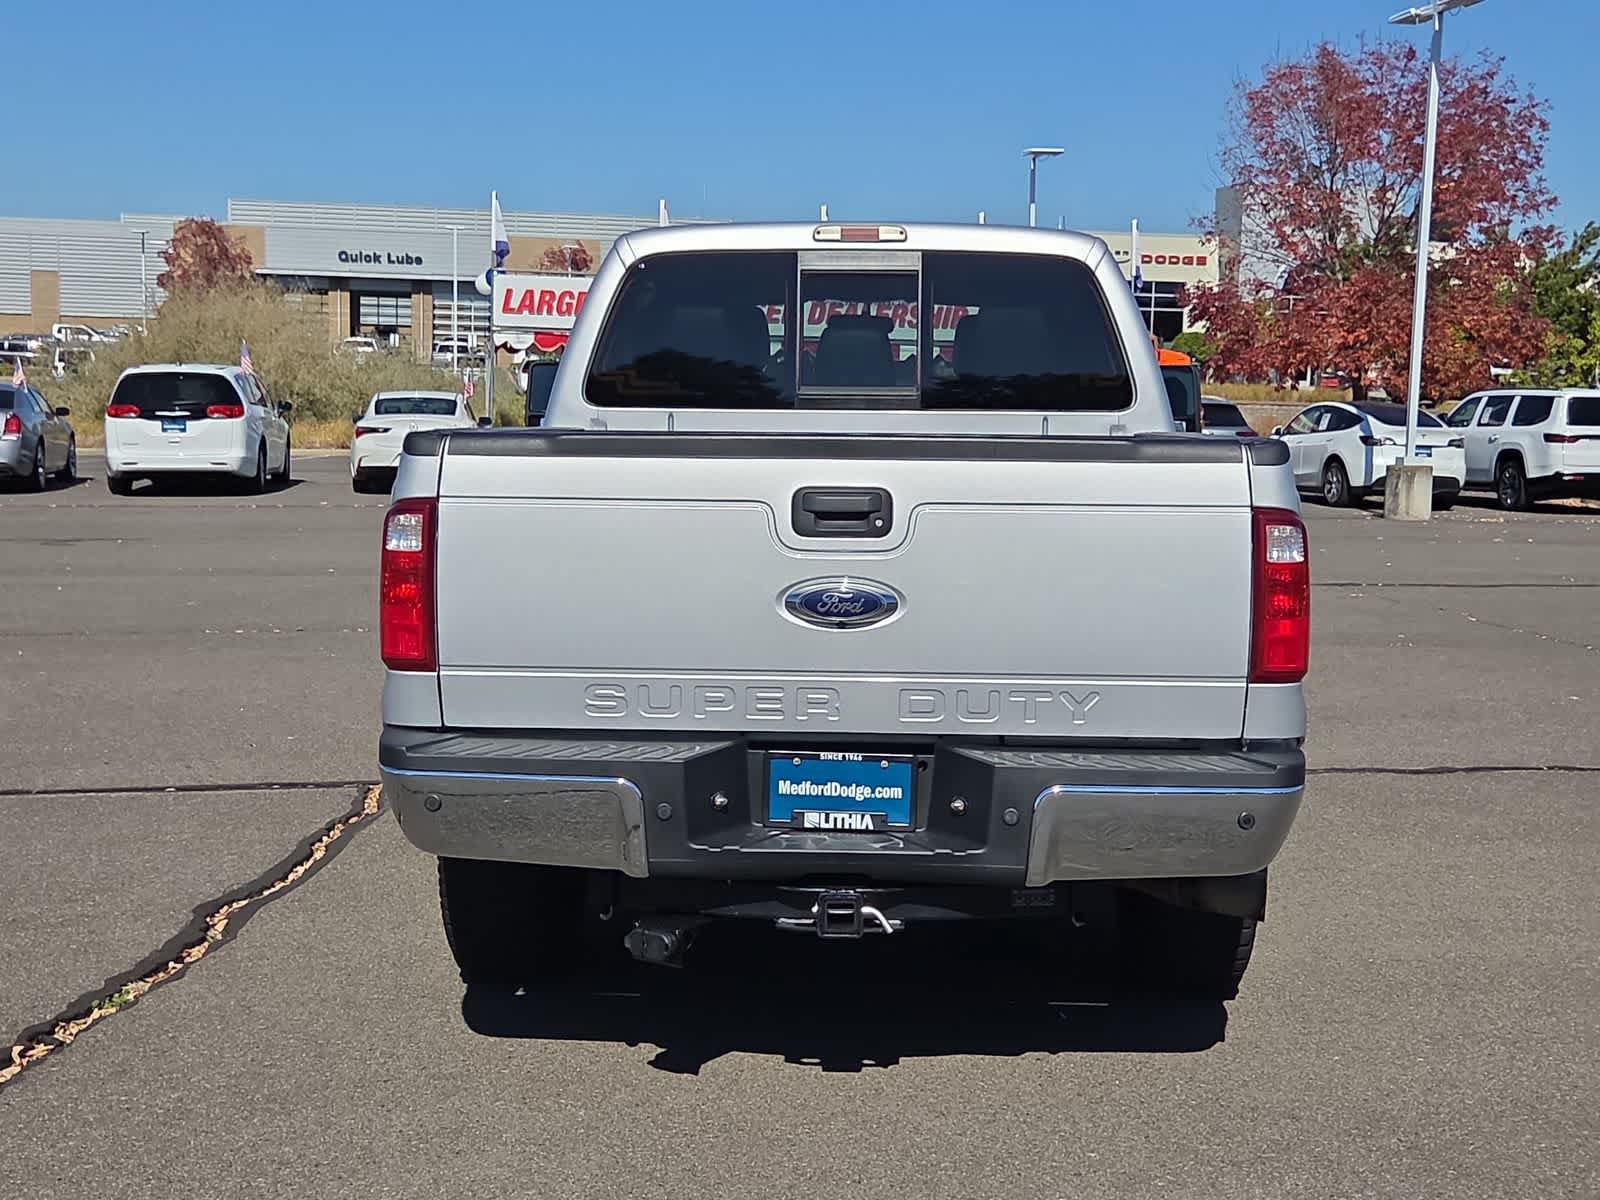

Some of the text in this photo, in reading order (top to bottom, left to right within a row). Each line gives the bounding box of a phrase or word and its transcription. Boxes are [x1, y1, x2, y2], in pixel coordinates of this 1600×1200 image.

[338, 250, 423, 266] Quick Lube
[1141, 254, 1207, 266] DODGE
[817, 592, 864, 613] Ford
[584, 684, 1100, 725] SUPER DUTY
[819, 752, 843, 761] SINCE
[778, 780, 902, 801] MedfordDodge.com
[820, 813, 874, 830] LITHIA
